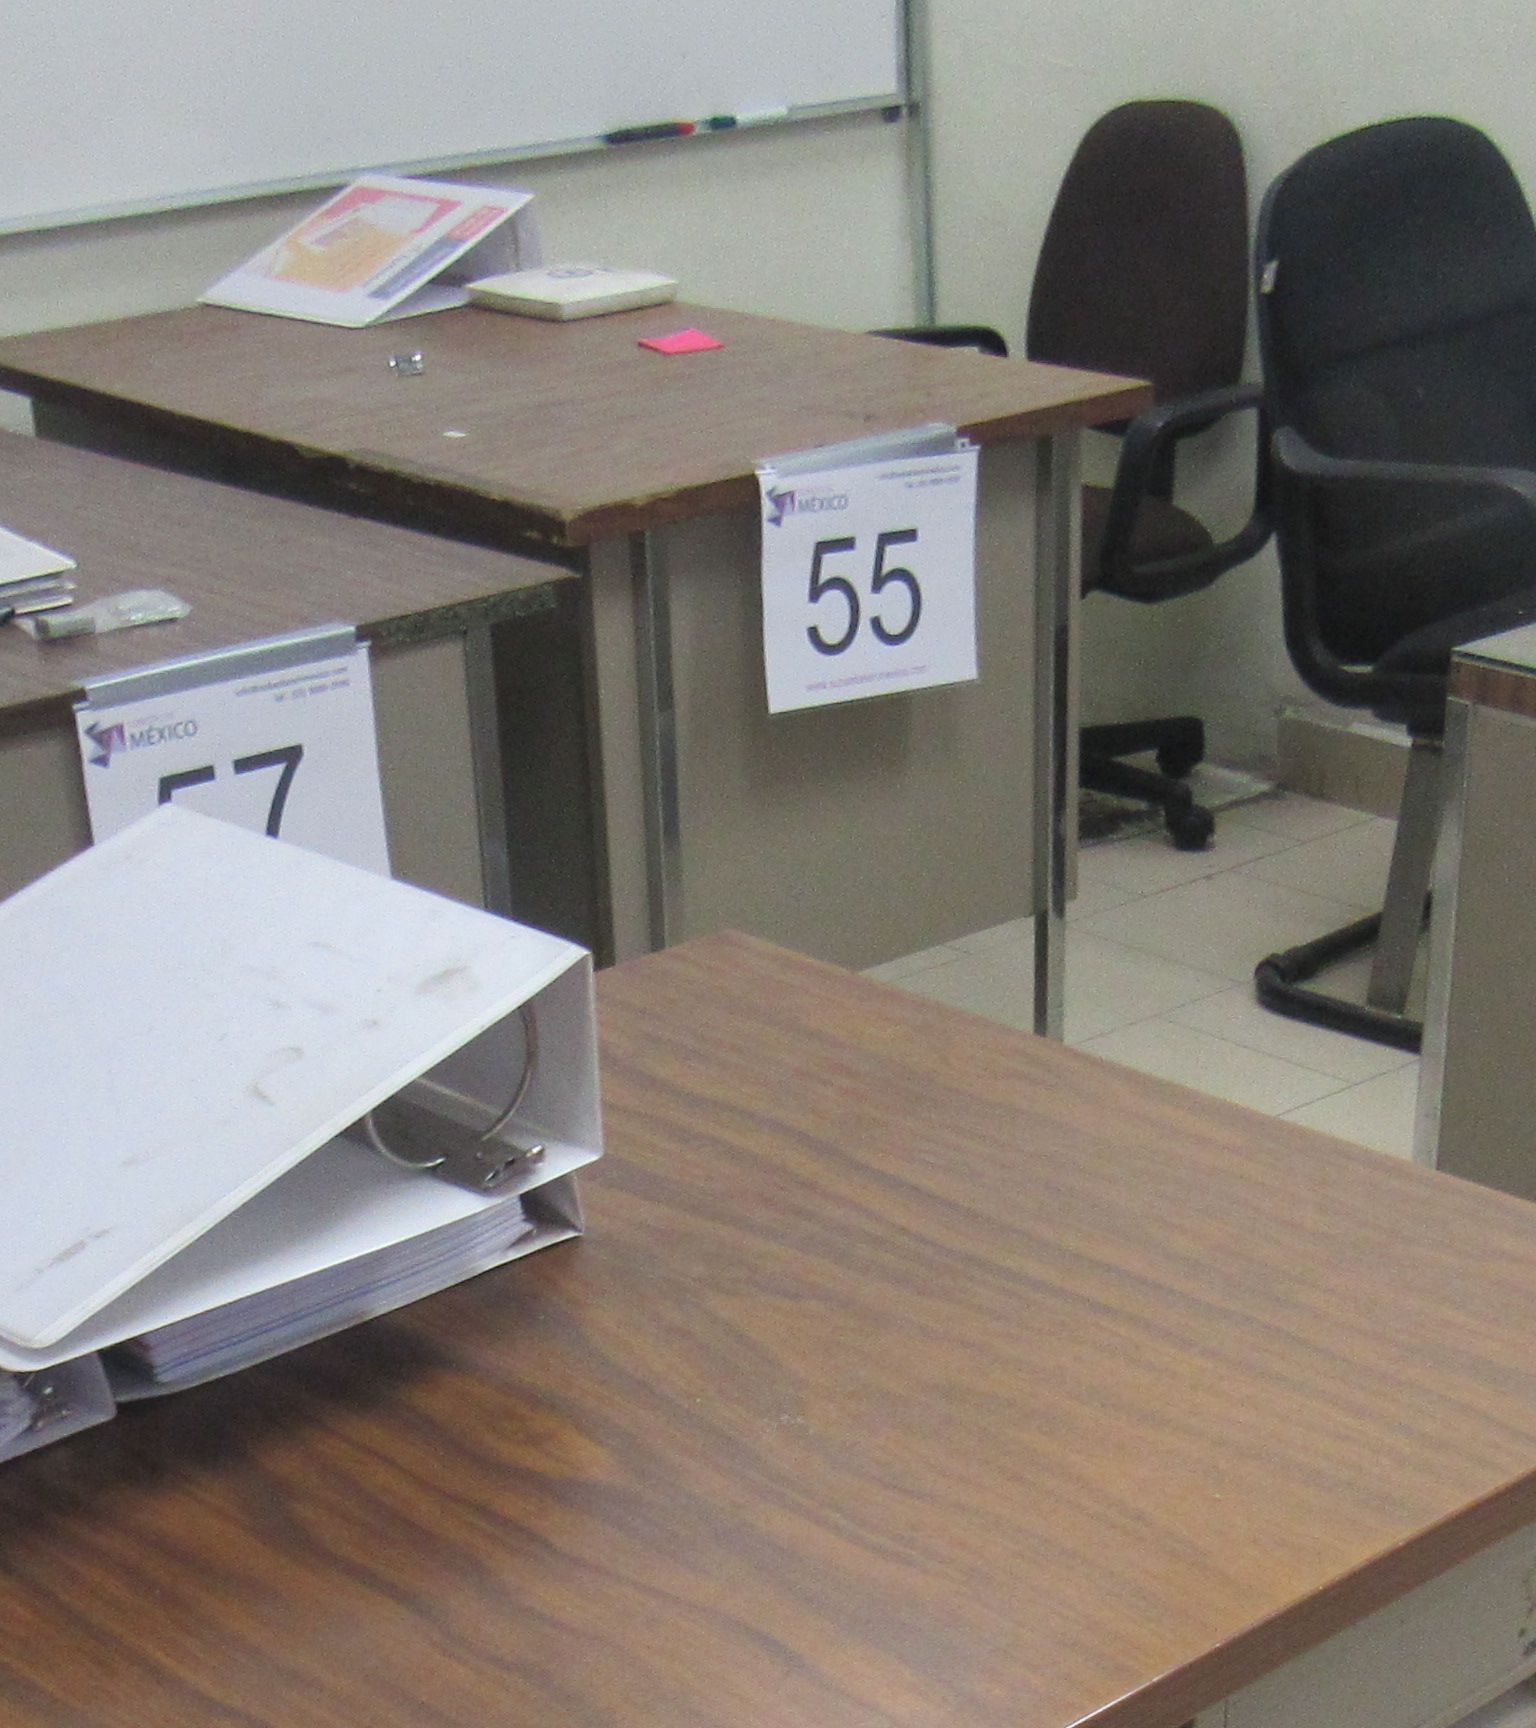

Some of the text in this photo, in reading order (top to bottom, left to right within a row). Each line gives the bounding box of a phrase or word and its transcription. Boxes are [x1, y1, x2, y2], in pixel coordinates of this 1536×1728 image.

[805, 527, 922, 657] 55
[129, 719, 198, 749] MÉXICO
[157, 743, 305, 840] 7
